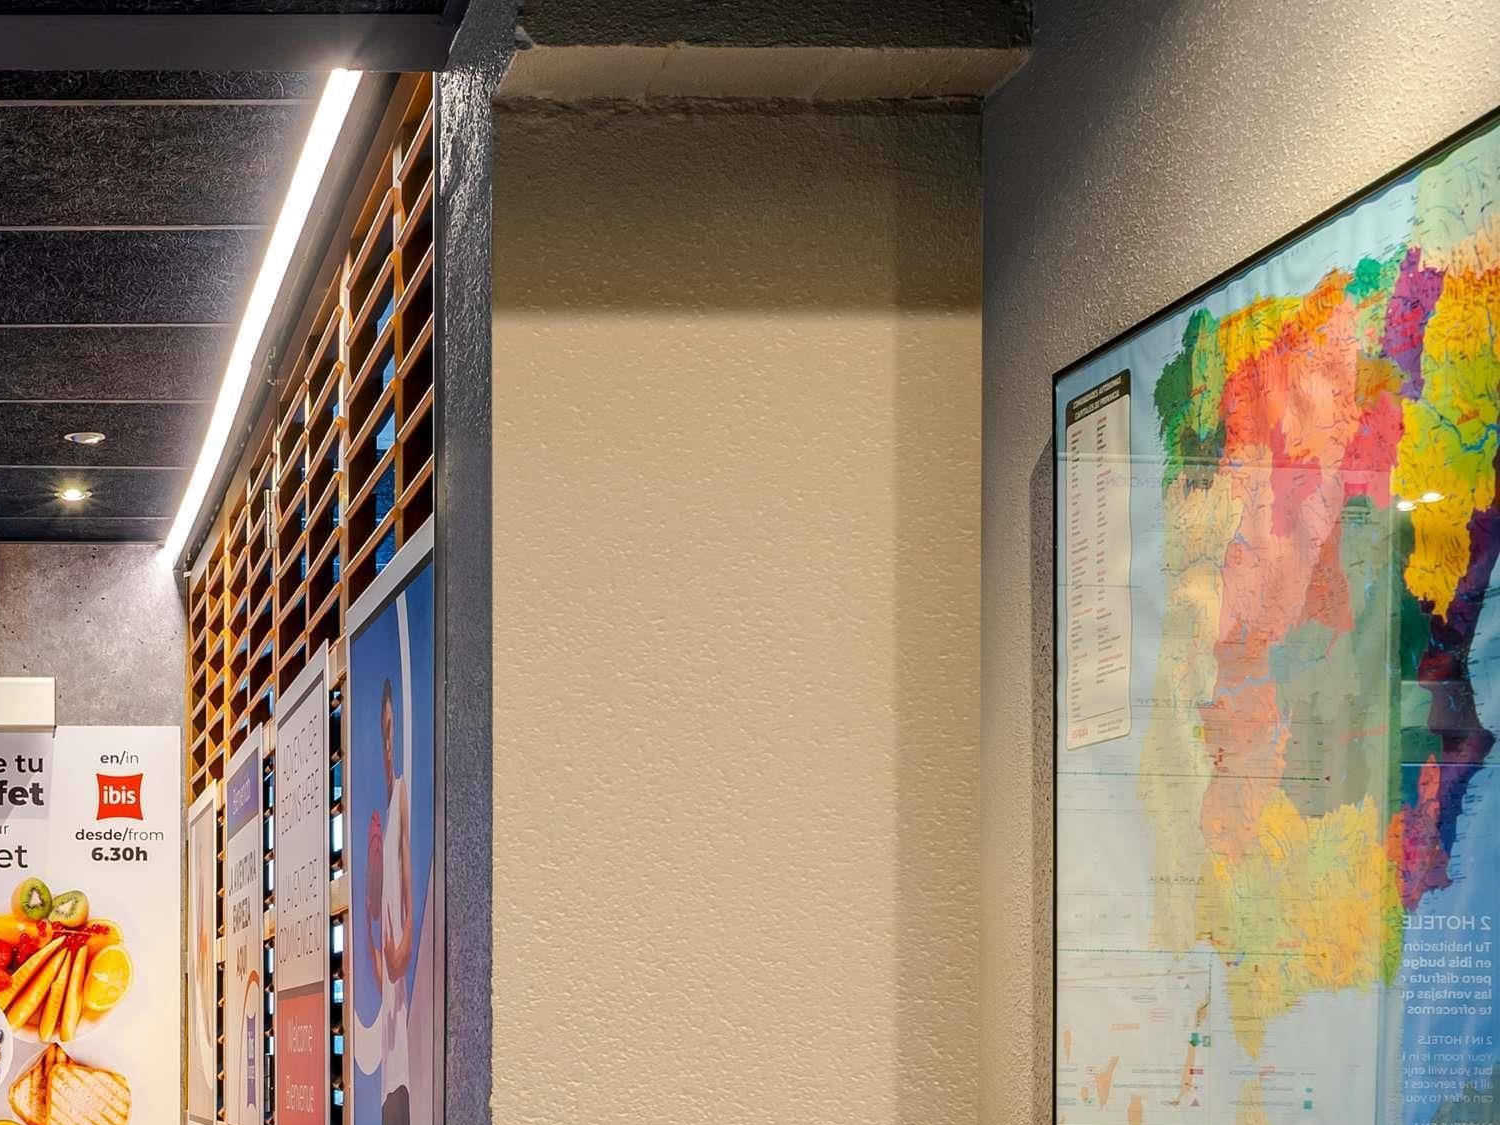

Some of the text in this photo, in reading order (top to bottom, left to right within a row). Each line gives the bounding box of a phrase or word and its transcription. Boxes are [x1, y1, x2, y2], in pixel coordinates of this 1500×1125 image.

[15, 755, 44, 773] tu
[103, 785, 136, 805] ibis
[75, 827, 164, 841] desde/from
[91, 847, 148, 862] 6.30h
